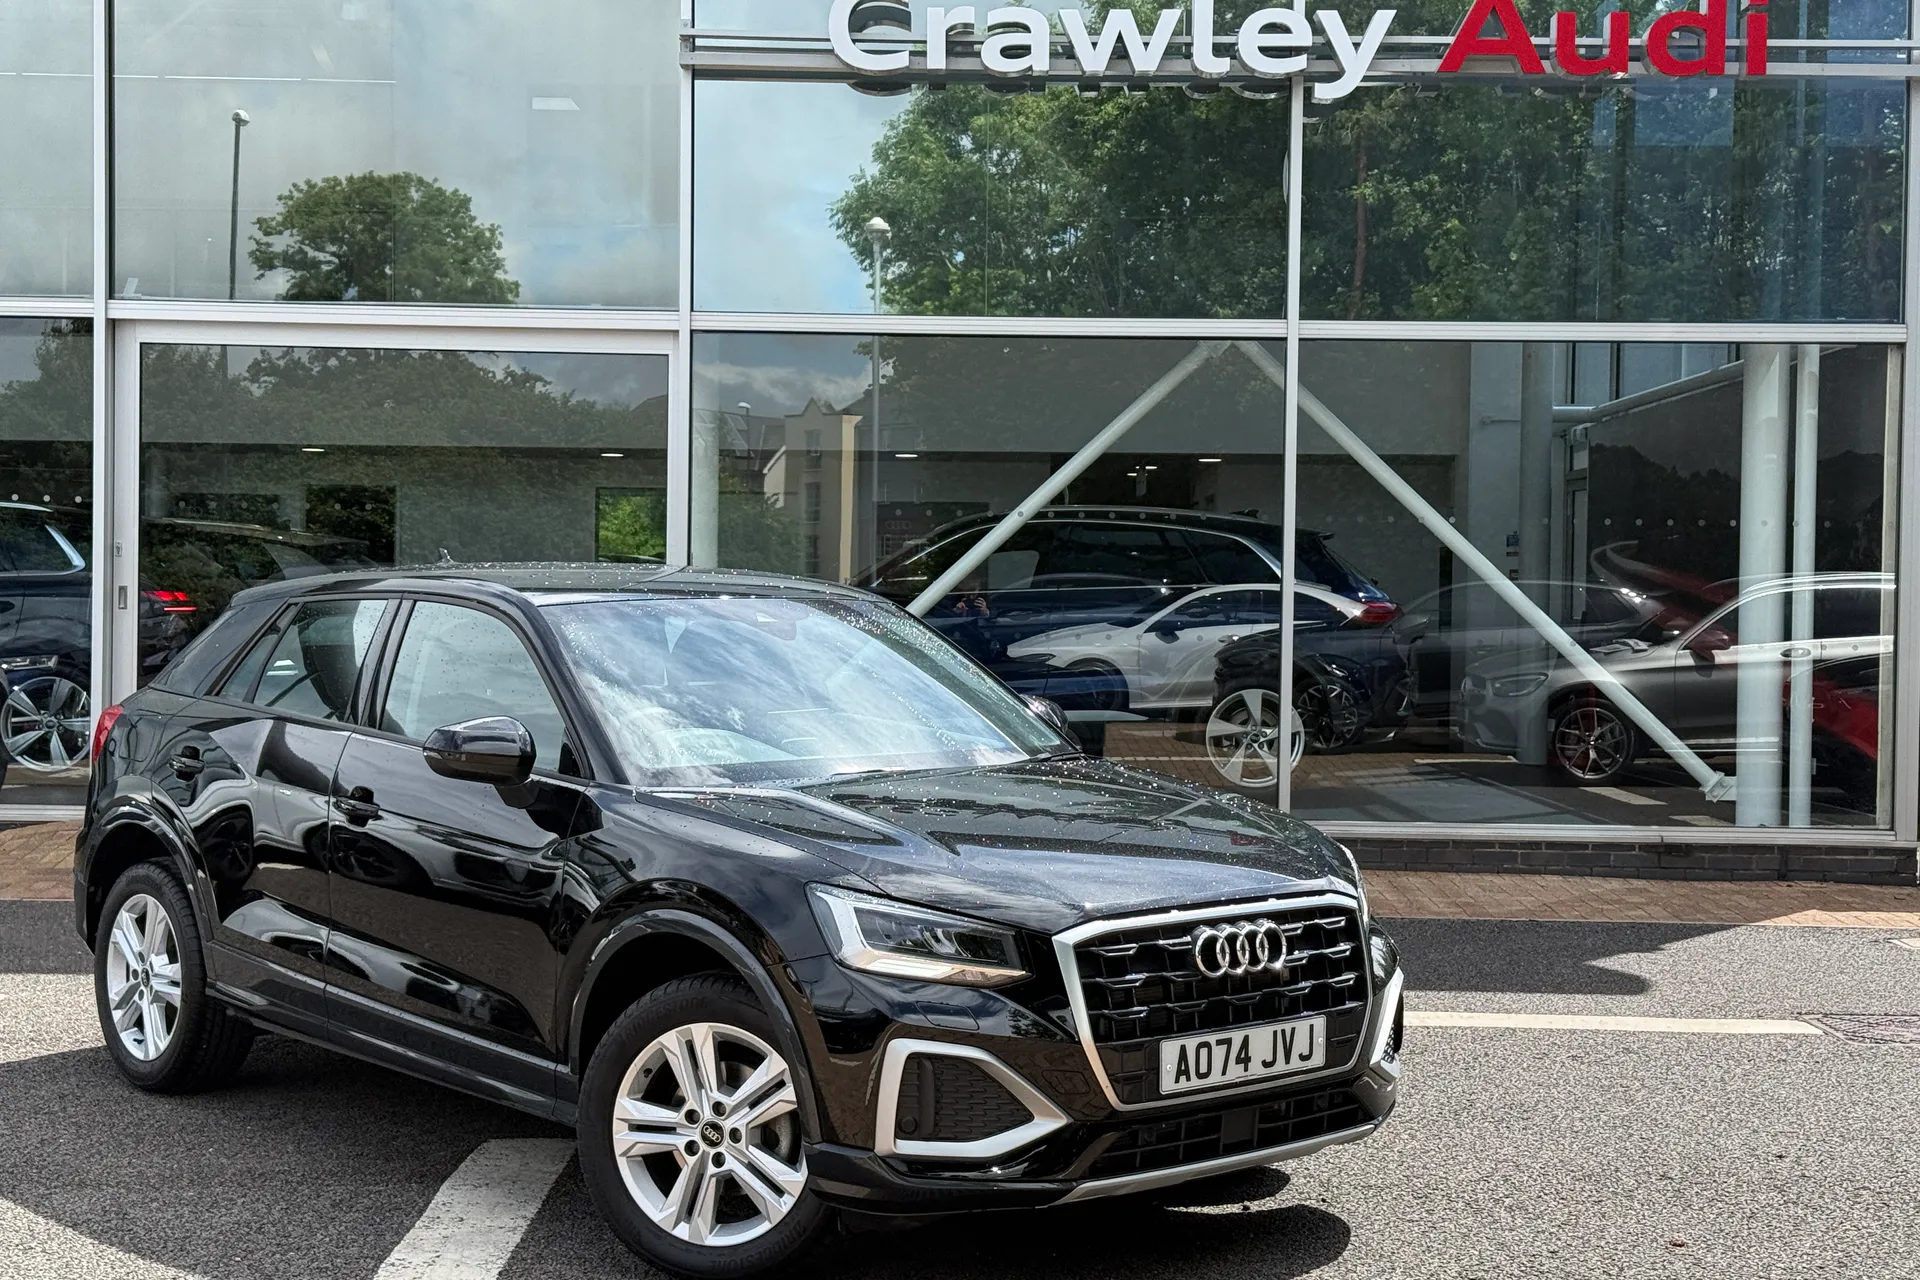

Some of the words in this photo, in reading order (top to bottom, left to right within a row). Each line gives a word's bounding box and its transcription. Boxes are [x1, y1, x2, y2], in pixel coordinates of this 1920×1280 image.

[829, 0, 1397, 100] Crawley
[1438, 0, 1768, 77] Audi
[1174, 1034, 1252, 1084] AO74
[1261, 1023, 1314, 1069] JVJ
